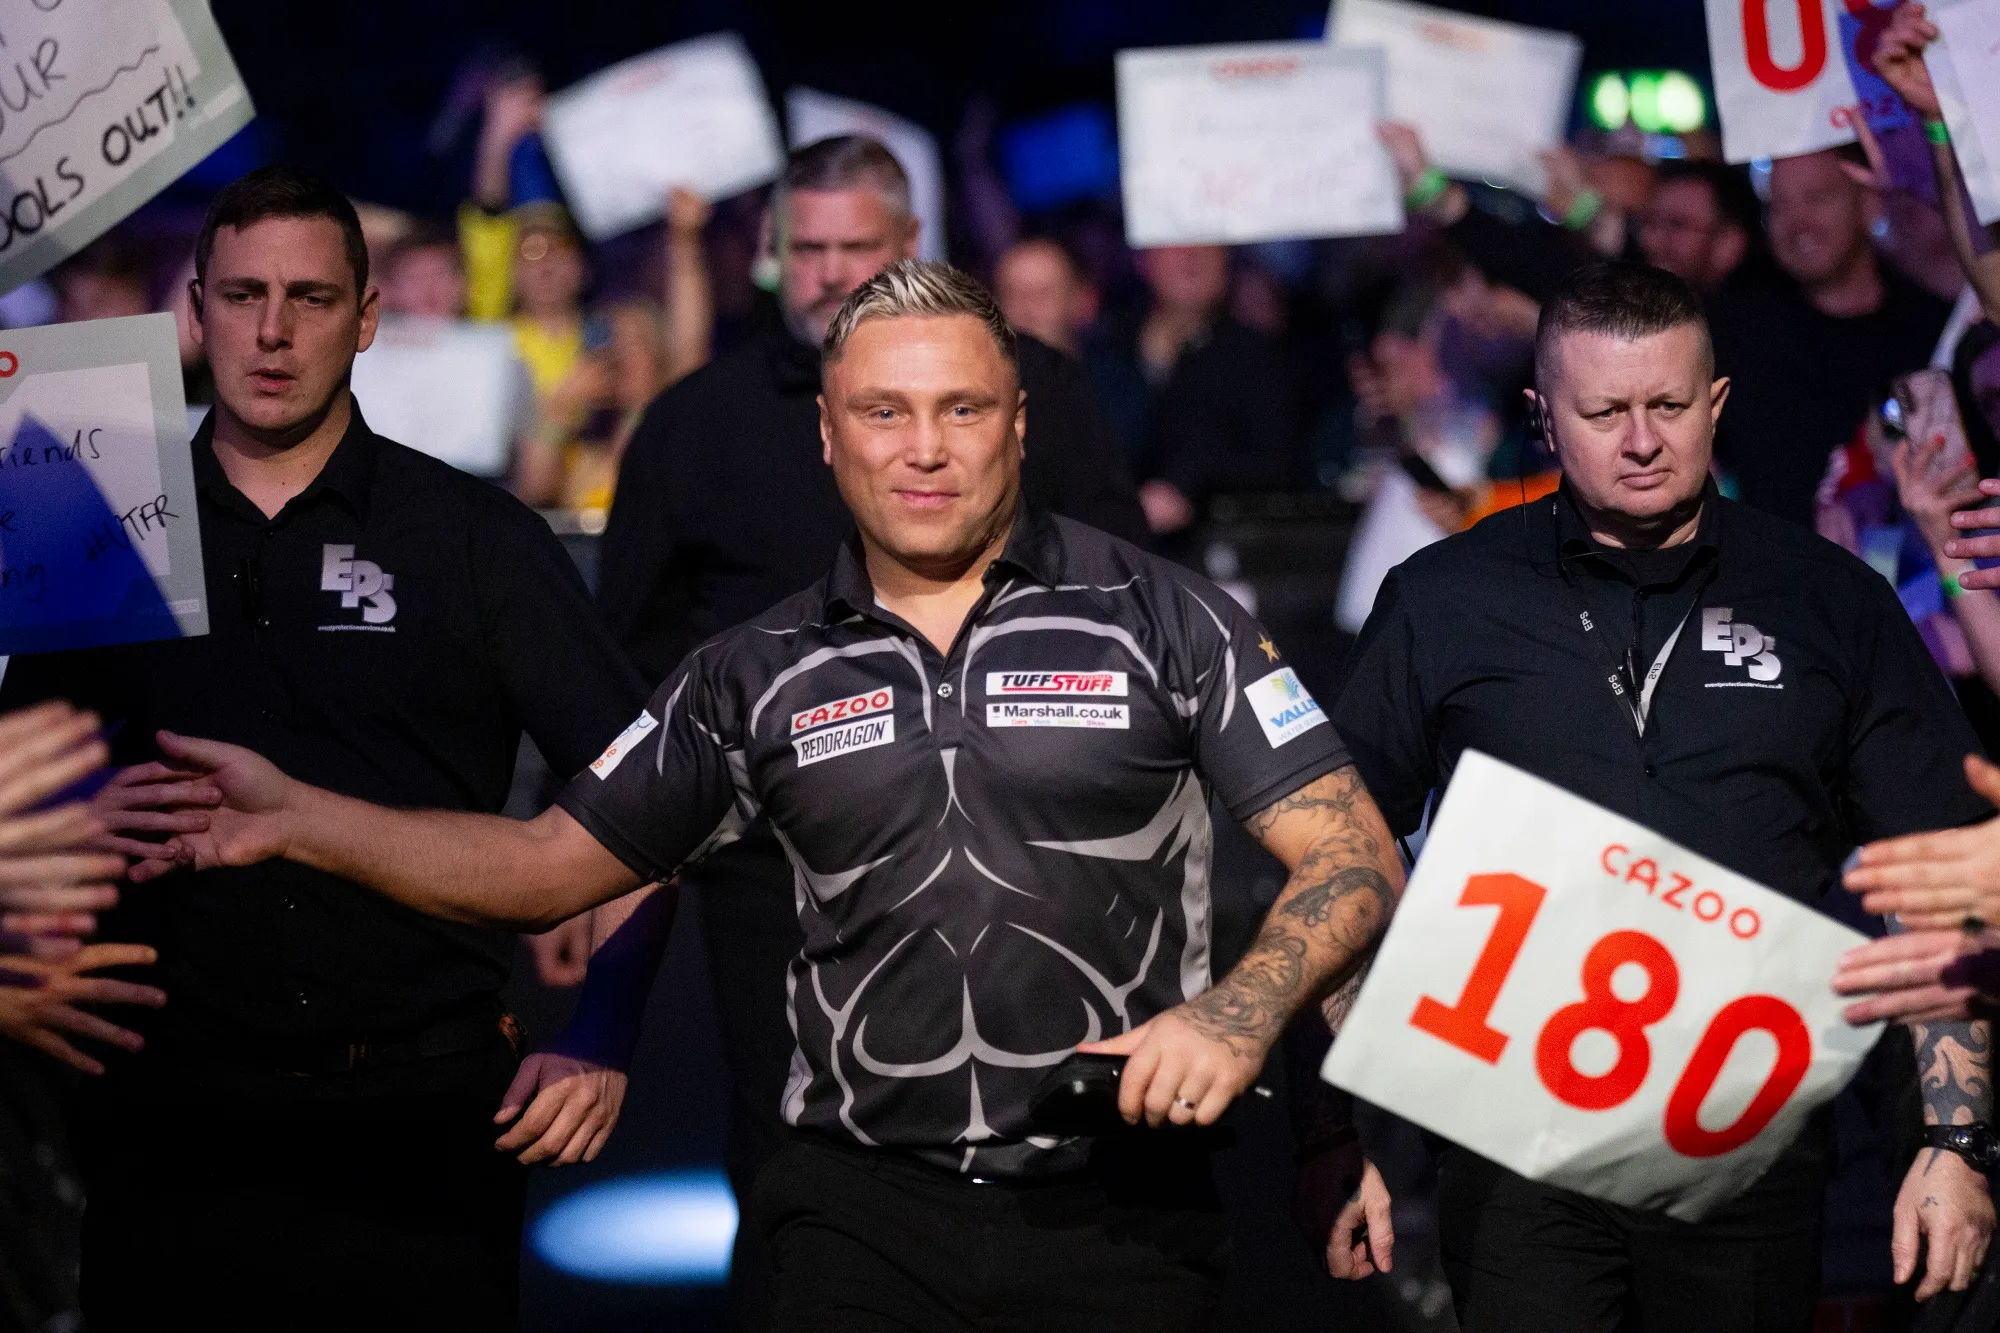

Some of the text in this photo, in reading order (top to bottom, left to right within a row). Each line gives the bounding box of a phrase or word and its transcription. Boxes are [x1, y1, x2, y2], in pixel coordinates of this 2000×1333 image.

[102, 64, 196, 167] OUT!!
[321, 543, 397, 623] EPS
[1580, 611, 1594, 632] EPS
[1702, 607, 1781, 681] EPS
[795, 691, 889, 730] CAZOO
[1004, 705, 1122, 720] Marshall.co.uk
[1608, 674, 1624, 696] EPS
[801, 719, 887, 762] REDDRAGON
[1600, 843, 1762, 940] CAZOO
[1408, 872, 1813, 1158] 180
